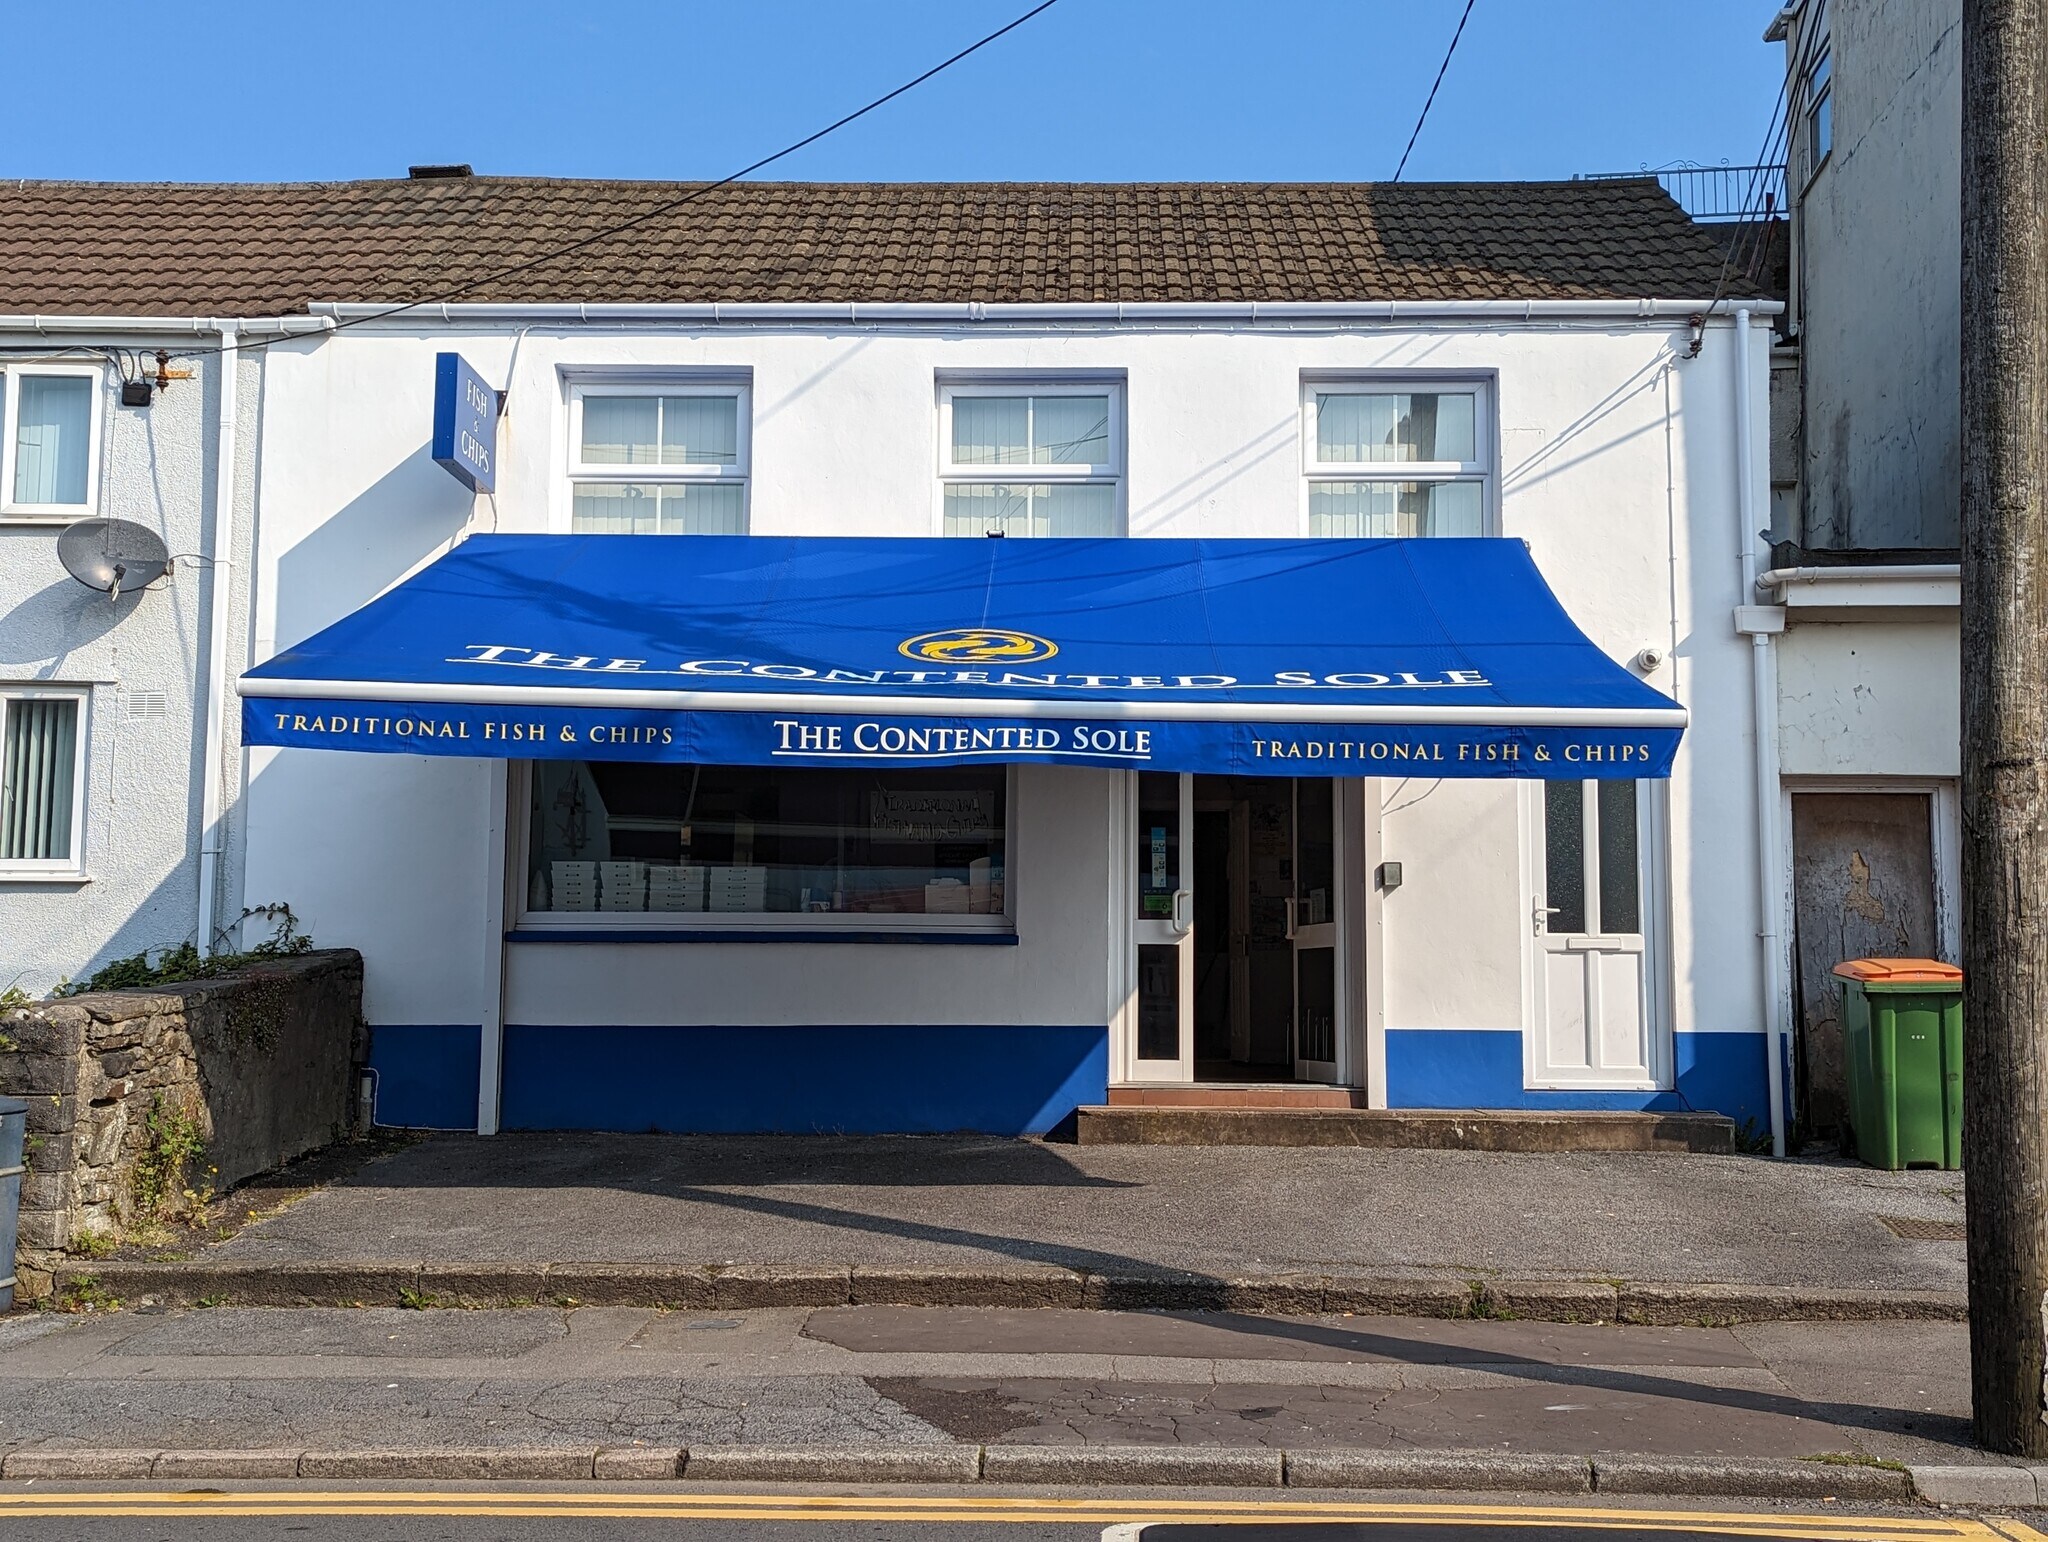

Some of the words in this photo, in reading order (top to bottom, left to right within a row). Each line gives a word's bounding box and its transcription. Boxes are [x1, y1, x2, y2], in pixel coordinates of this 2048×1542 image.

[466, 378, 488, 418] FISH
[473, 417, 480, 433] &
[461, 429, 489, 474] CHIPS
[465, 644, 647, 671] THE
[679, 660, 1237, 687] CONTENTED
[1274, 670, 1489, 686] SOLE
[274, 713, 470, 738] TRADITIONAL
[484, 722, 545, 741] FISH
[559, 725, 577, 742] &
[589, 726, 673, 744] CHIPS
[773, 720, 842, 751] THE
[853, 723, 1060, 752] CONTENTED
[1072, 727, 1151, 753] SOLE
[1251, 740, 1444, 761] TRADITIONAL
[1459, 744, 1519, 761] FISH
[1534, 744, 1552, 762] &
[1564, 744, 1649, 762] CHIPS
